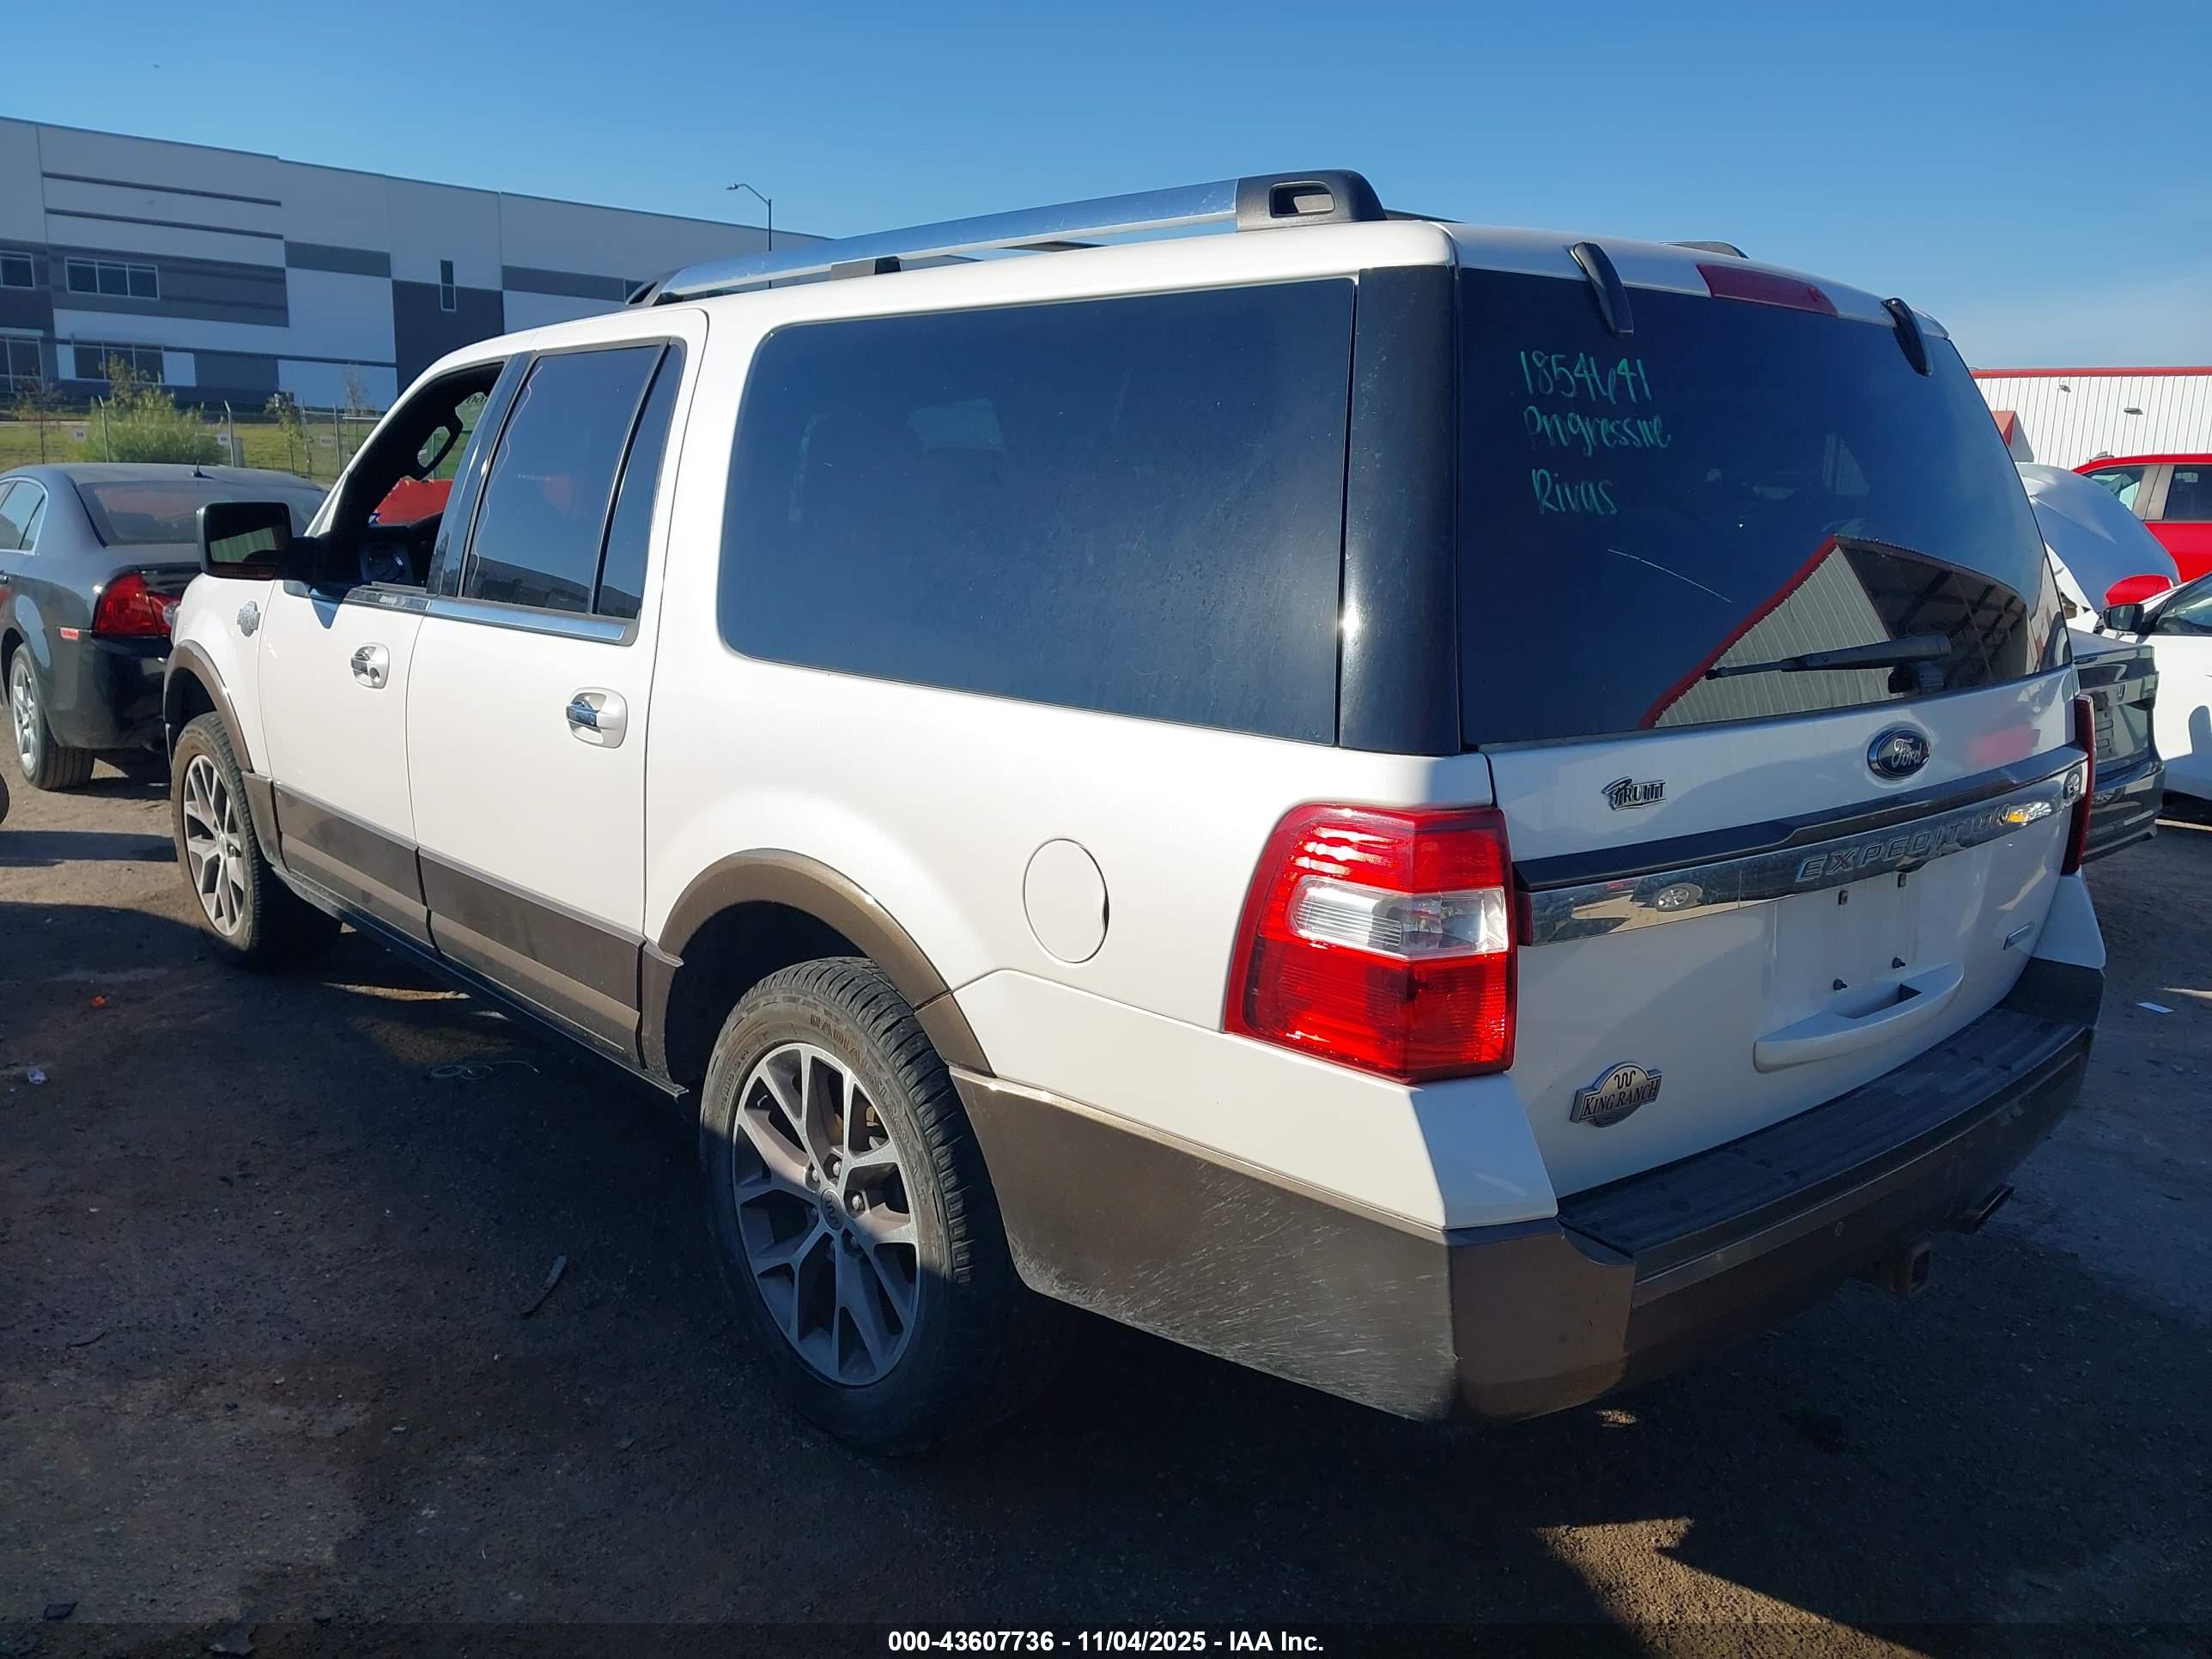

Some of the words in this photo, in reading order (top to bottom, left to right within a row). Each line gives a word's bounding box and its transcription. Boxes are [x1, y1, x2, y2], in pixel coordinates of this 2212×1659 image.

[1531, 468, 1618, 515] Rivas
[1796, 803, 2009, 883] EXPEDITION
[1583, 1094, 1616, 1116] KING
[1616, 1079, 1660, 1109] RANCH
